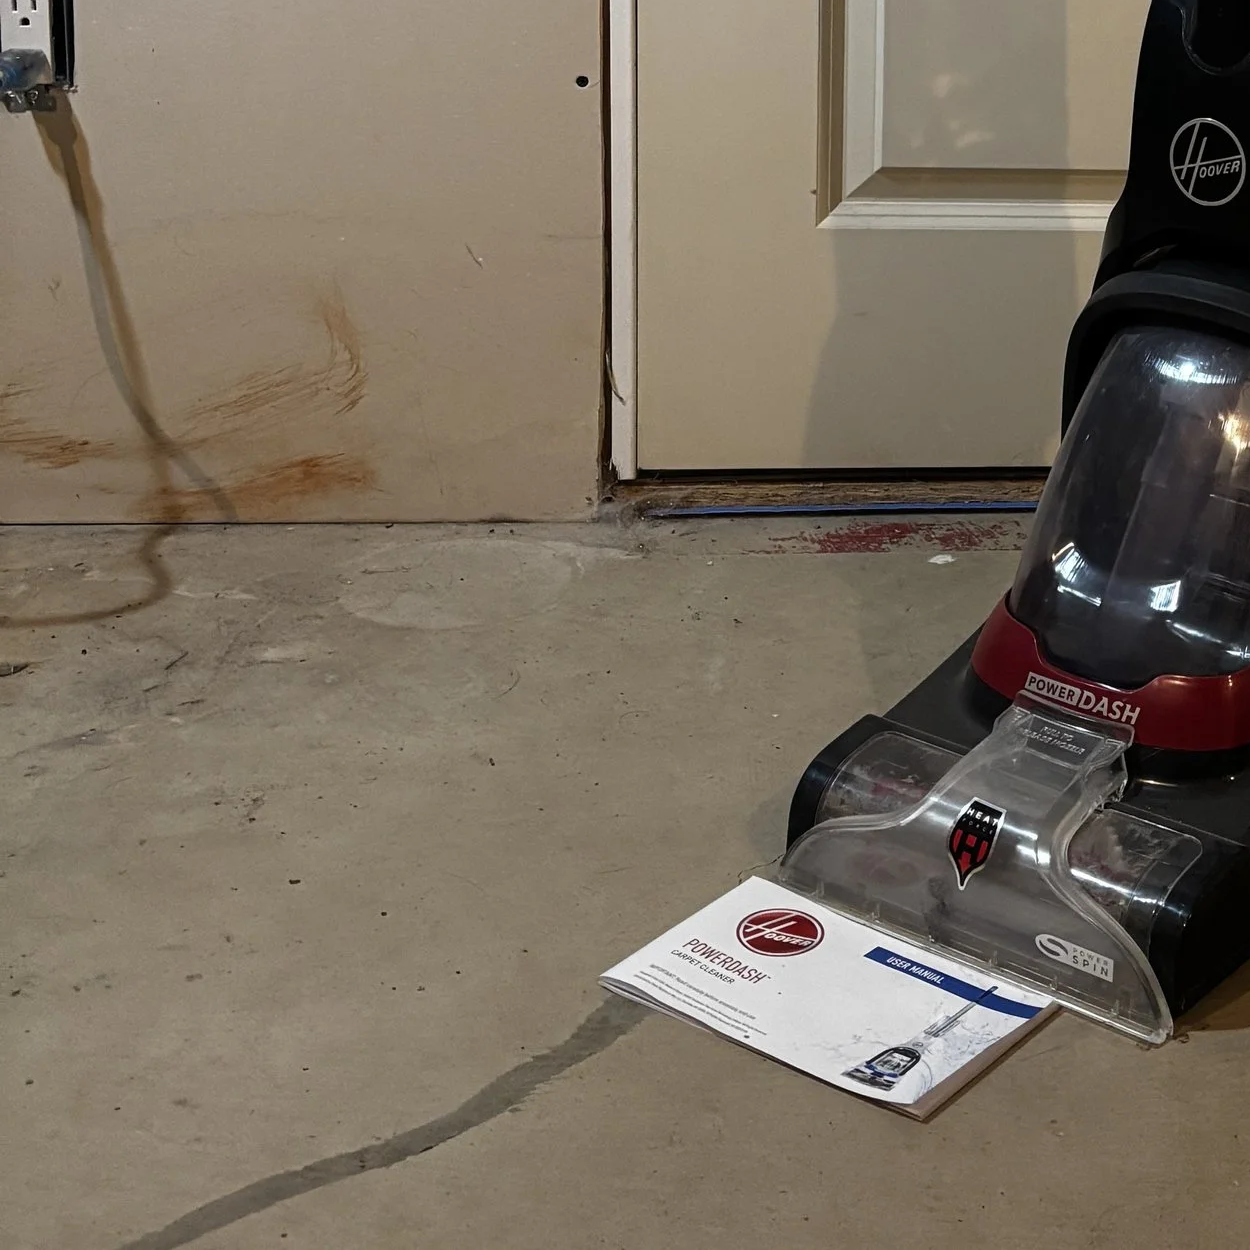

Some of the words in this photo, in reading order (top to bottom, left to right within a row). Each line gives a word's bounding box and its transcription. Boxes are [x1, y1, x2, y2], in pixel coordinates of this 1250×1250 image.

[1173, 121, 1241, 196] HOOVER
[966, 807, 999, 827] HEAT
[744, 912, 817, 948] HOOVER
[671, 949, 701, 967] CARPET
[699, 963, 736, 985] CLEANER
[886, 956, 911, 970] USER
[908, 966, 945, 985] MANUAL
[1072, 947, 1109, 967] POWER
[1072, 955, 1109, 977] SPIN
